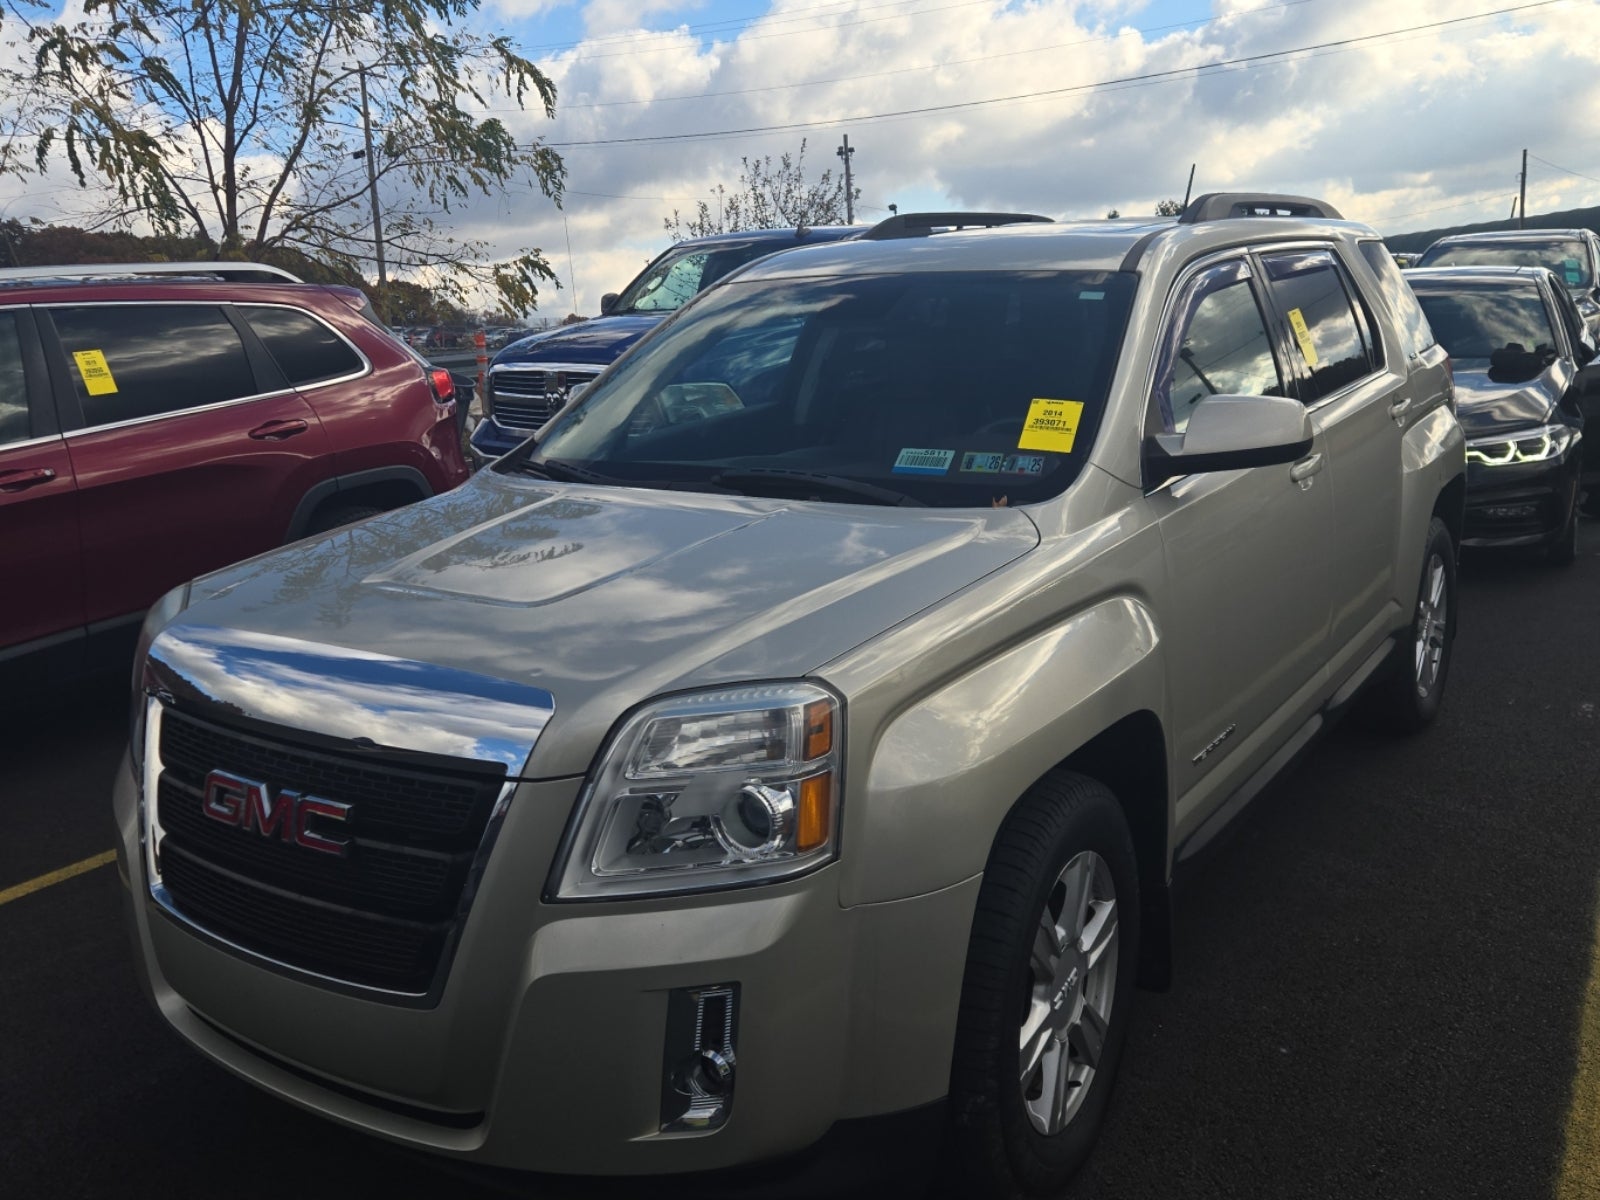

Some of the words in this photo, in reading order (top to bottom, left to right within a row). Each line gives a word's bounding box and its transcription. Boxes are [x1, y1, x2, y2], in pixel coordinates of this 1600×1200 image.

[1042, 409, 1063, 417] 2014
[988, 455, 1001, 470] 26
[1030, 457, 1043, 473] 25
[203, 769, 353, 855] GMC
